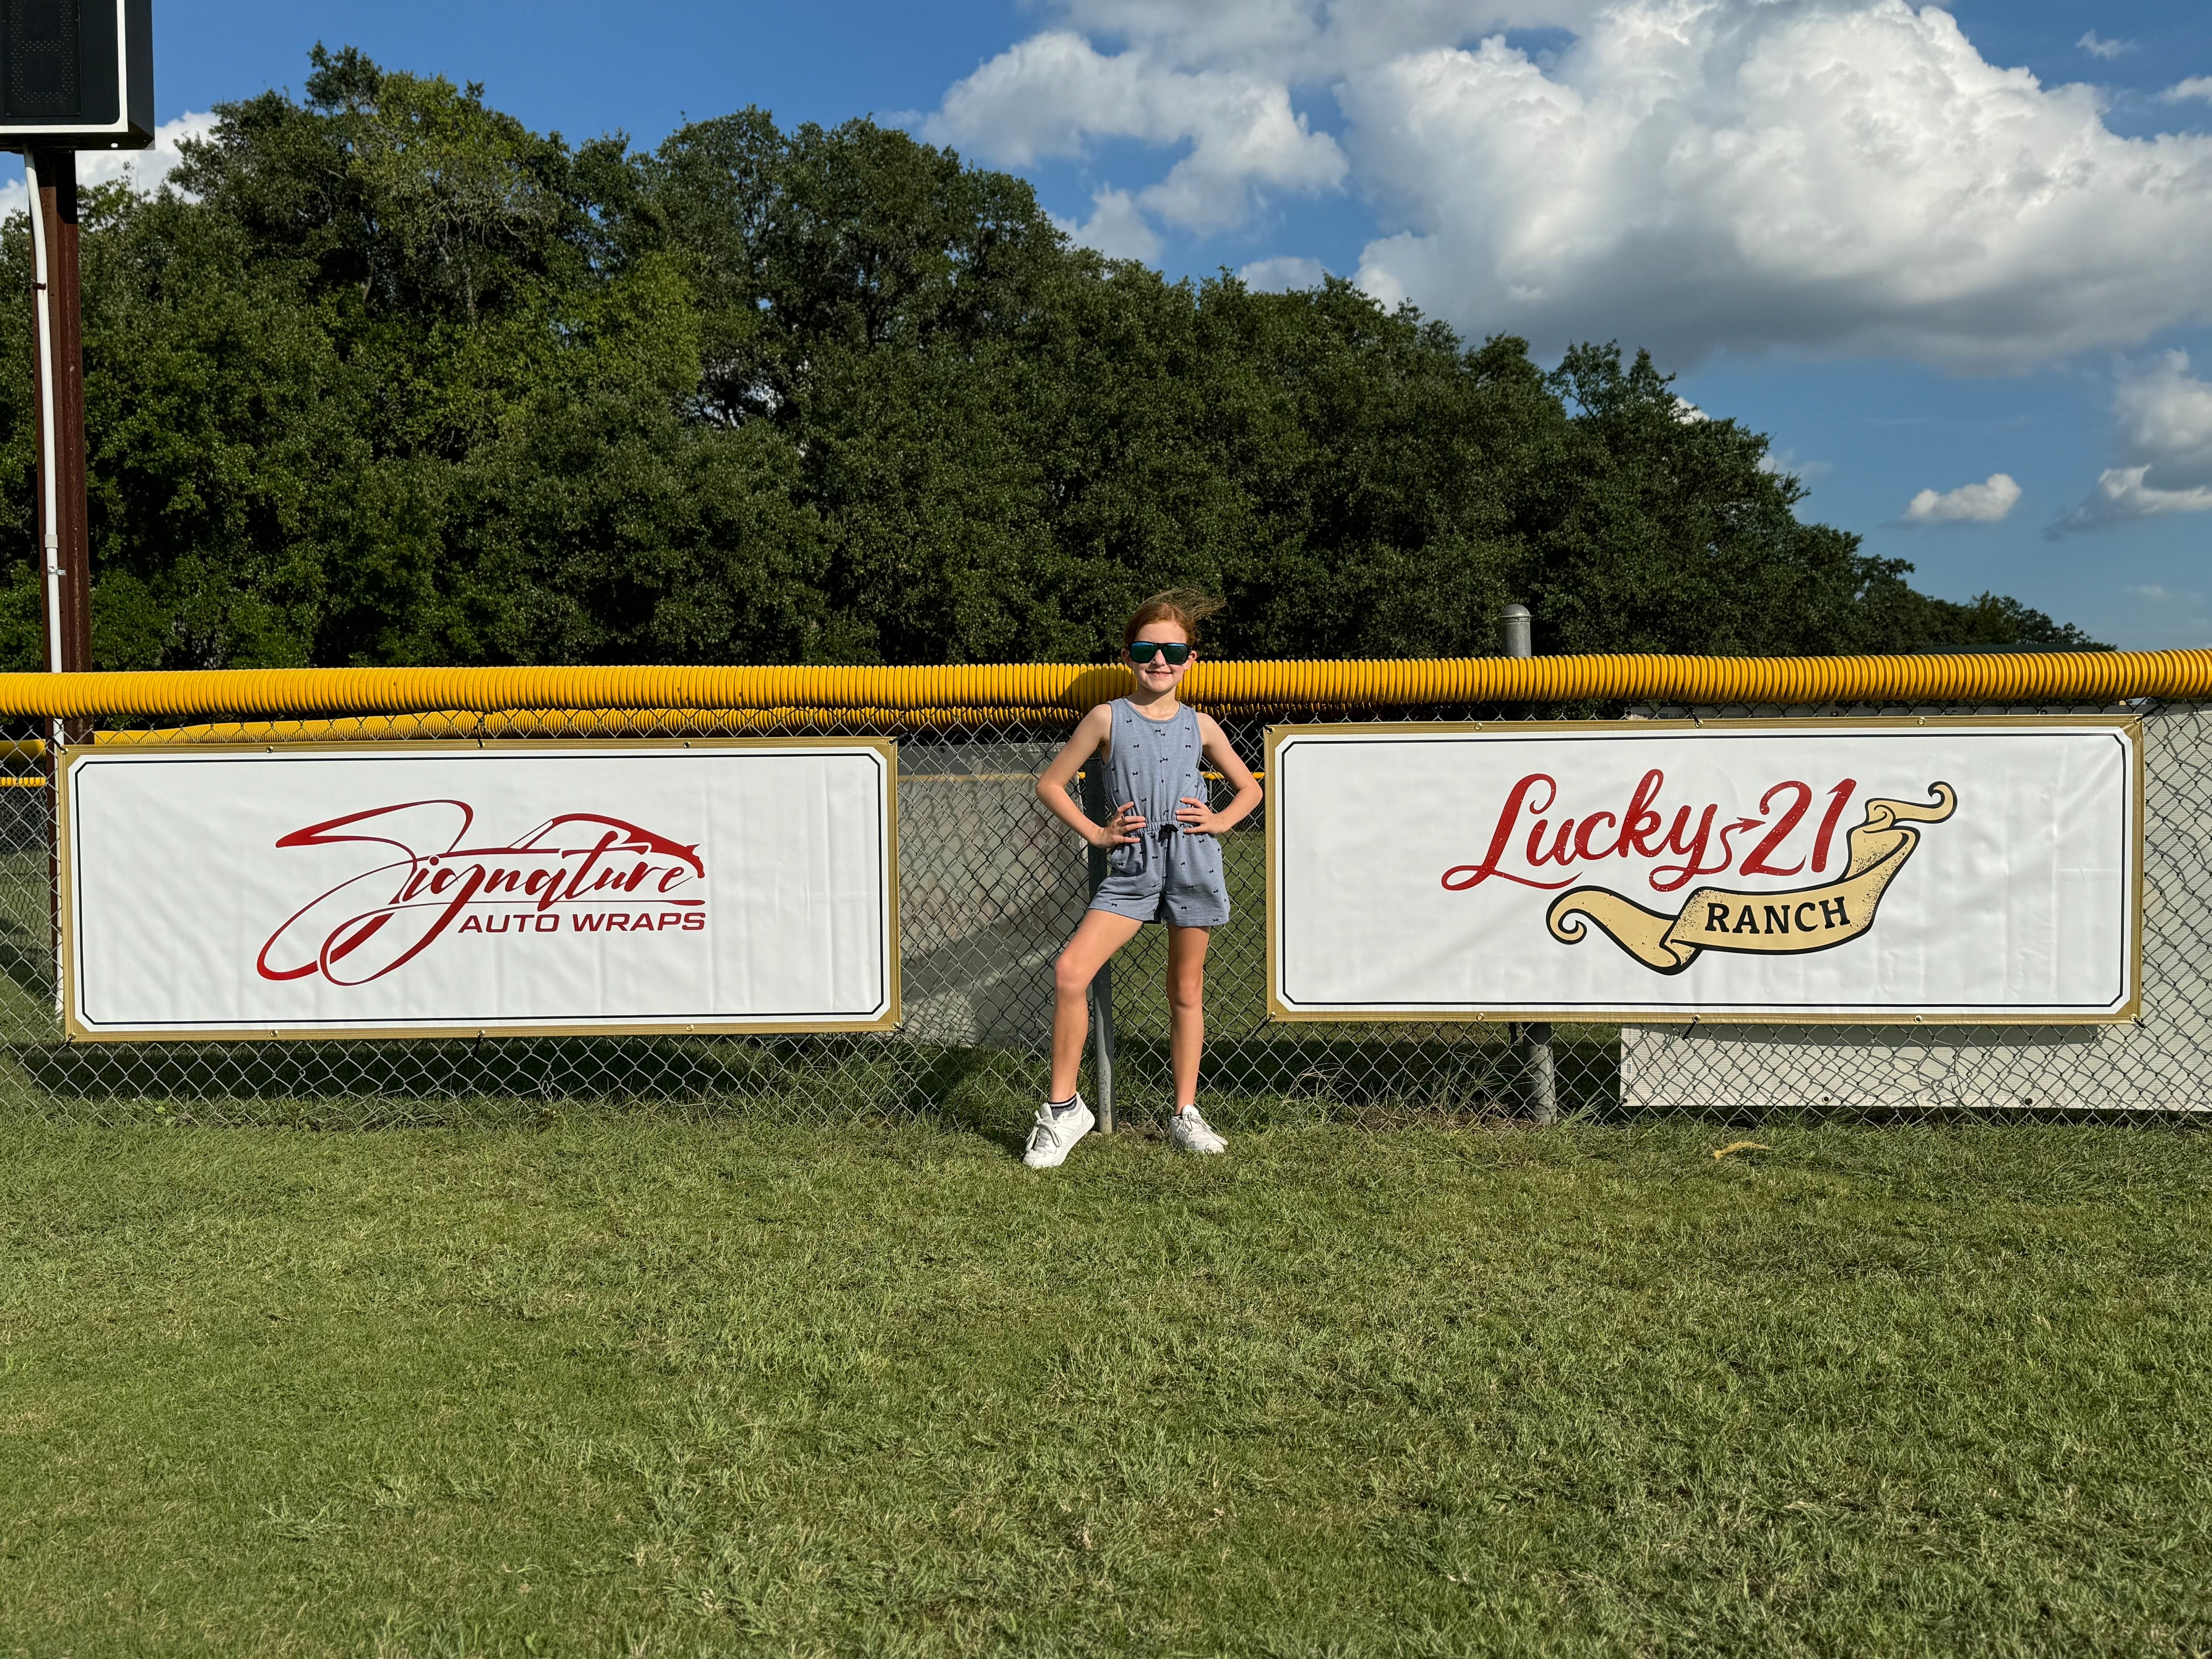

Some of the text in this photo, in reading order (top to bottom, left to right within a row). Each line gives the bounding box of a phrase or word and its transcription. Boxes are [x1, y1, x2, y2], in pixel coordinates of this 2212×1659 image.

[1441, 769, 1856, 892] Lucky 21
[257, 800, 694, 986] Signature
[458, 912, 706, 933] AUTO WRAPS
[1705, 896, 1851, 934] RANCH
